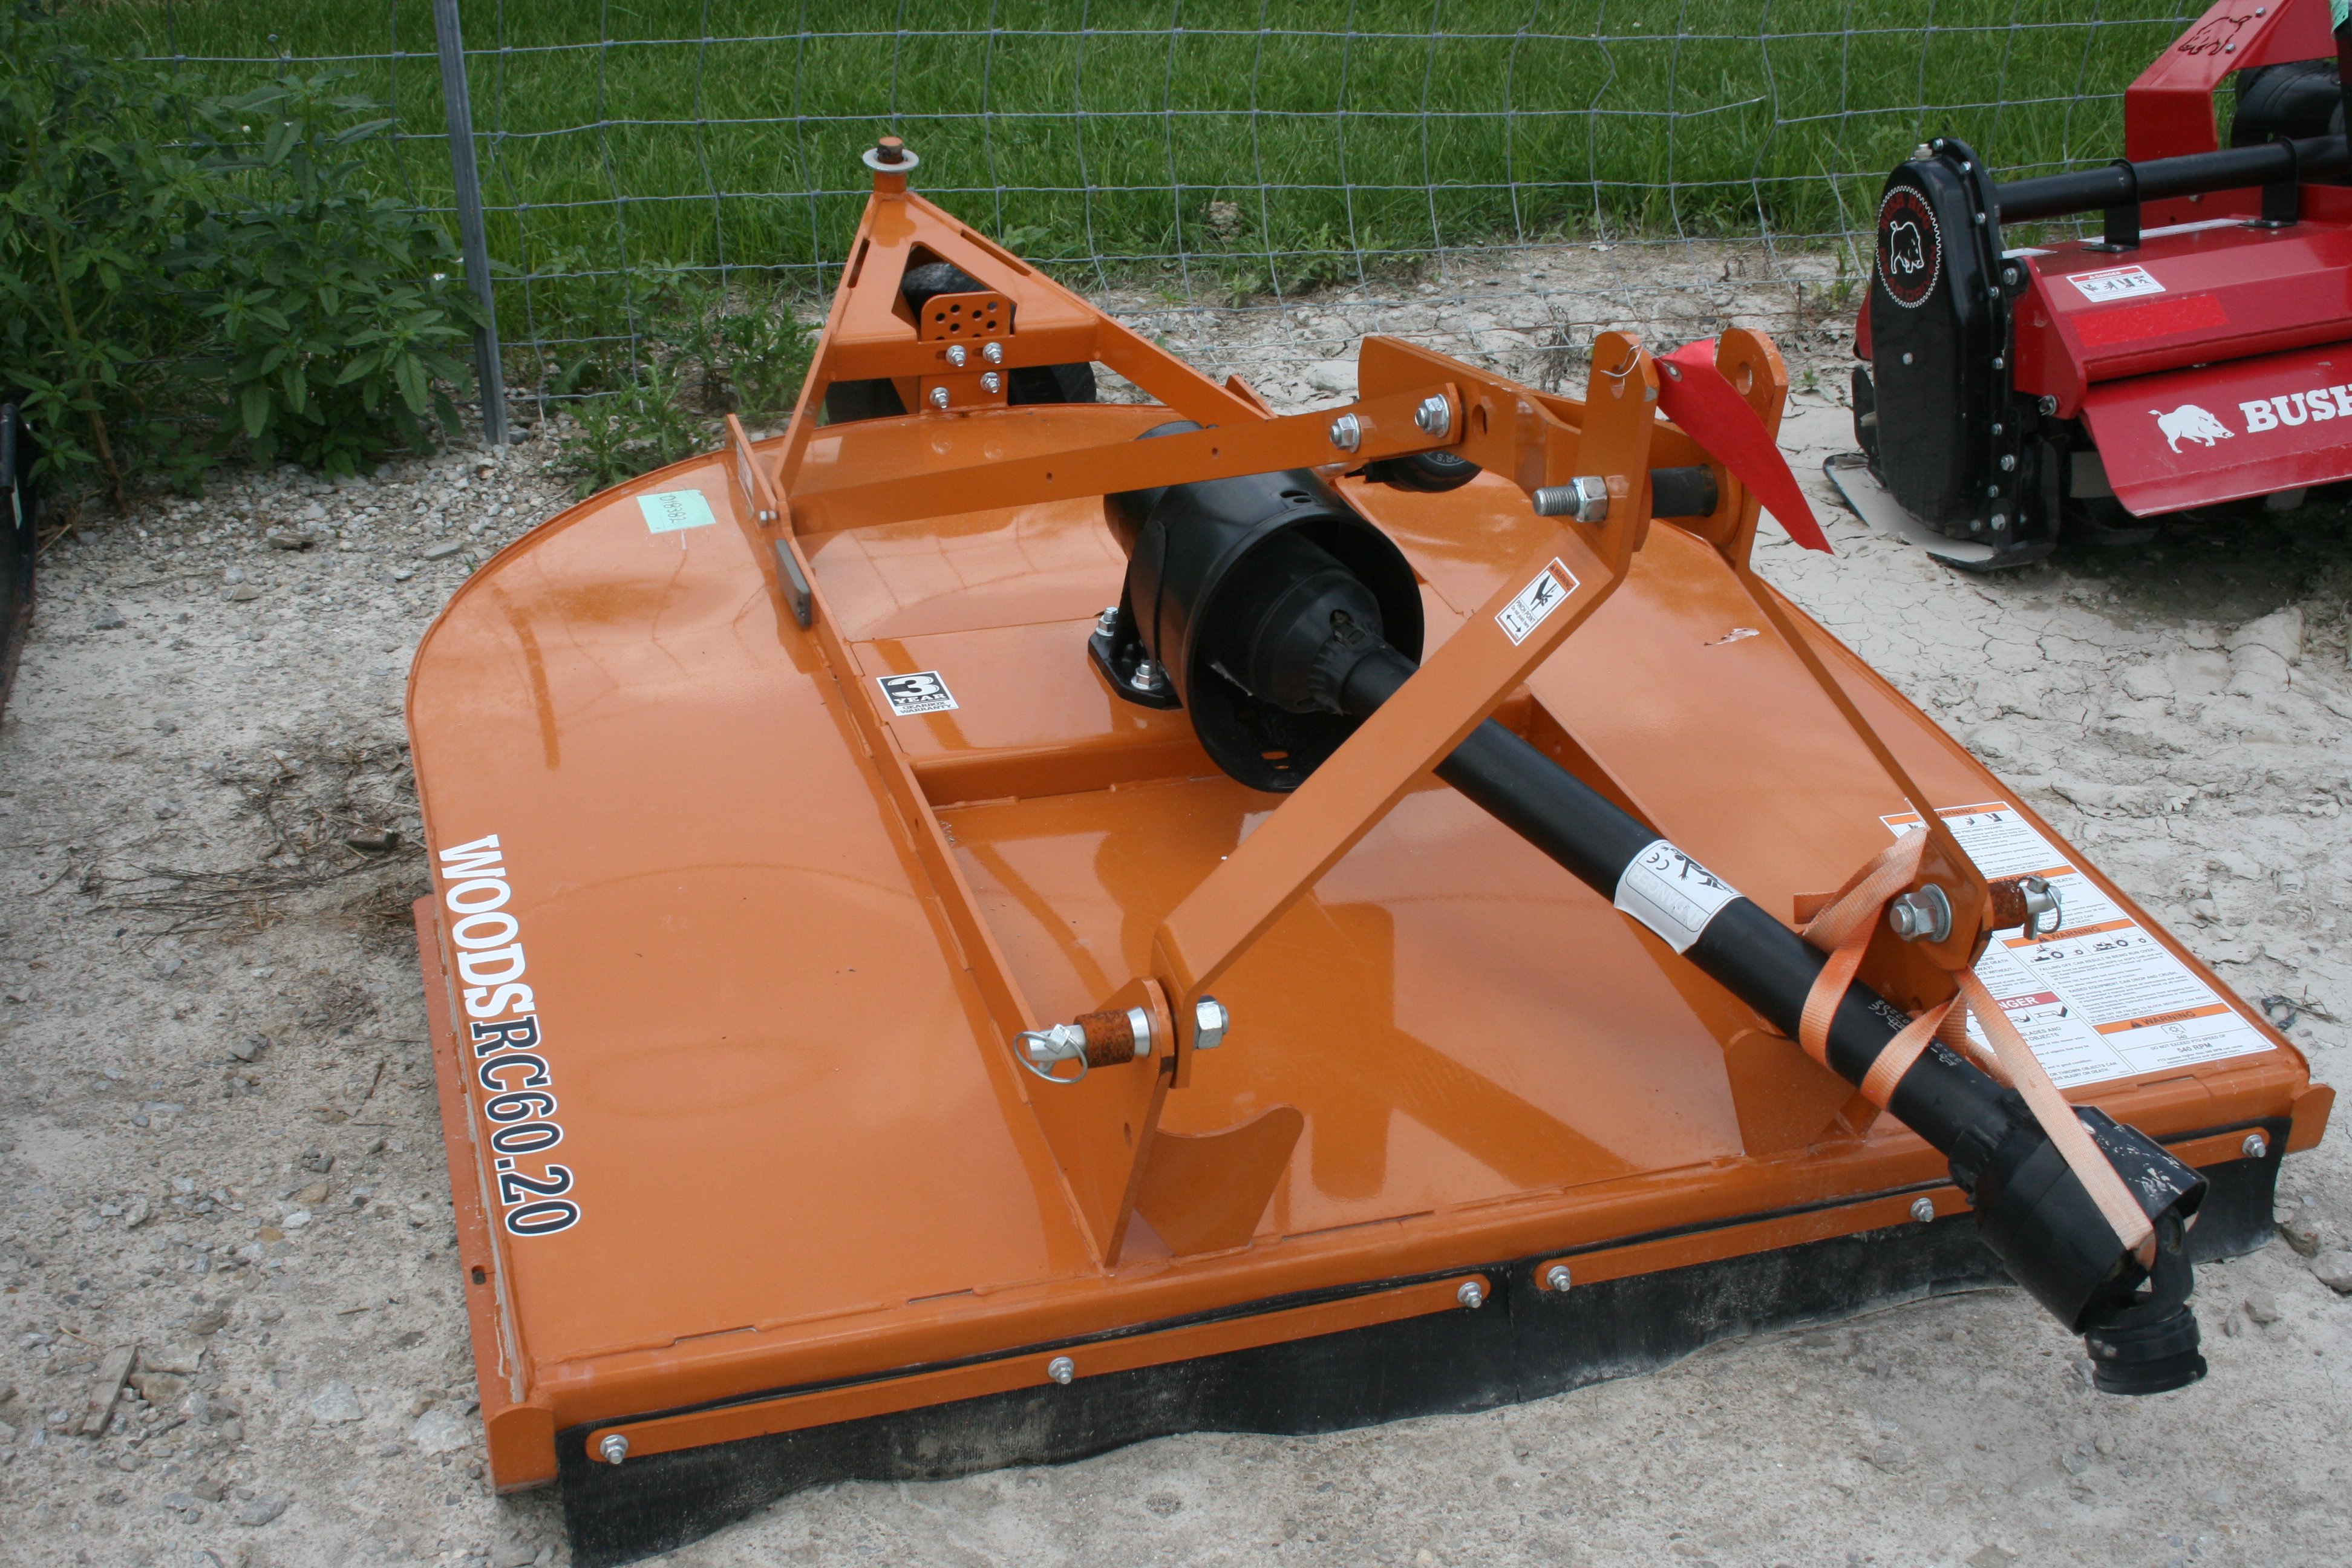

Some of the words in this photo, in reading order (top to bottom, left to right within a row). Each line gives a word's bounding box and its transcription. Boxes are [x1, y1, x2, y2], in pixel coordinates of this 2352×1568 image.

[1907, 194, 1931, 230] HOG
[2238, 384, 2352, 433] BUSH
[1553, 566, 1574, 590] WARNING
[1515, 599, 1526, 613] PINCH
[1524, 609, 1537, 624] POINT
[887, 676, 940, 697] 3
[893, 693, 947, 704] YEAR
[900, 704, 952, 714] WARRANTY
[903, 701, 947, 710] GEARBOX
[1938, 808, 1978, 817] ARNING
[1630, 869, 1688, 915] DANGER
[439, 834, 536, 1019] WOODS
[2048, 926, 2101, 939] WARNING
[1998, 996, 2039, 1010] NGER
[2141, 1011, 2196, 1025] WARNING
[469, 1016, 581, 1238] RC60.20
